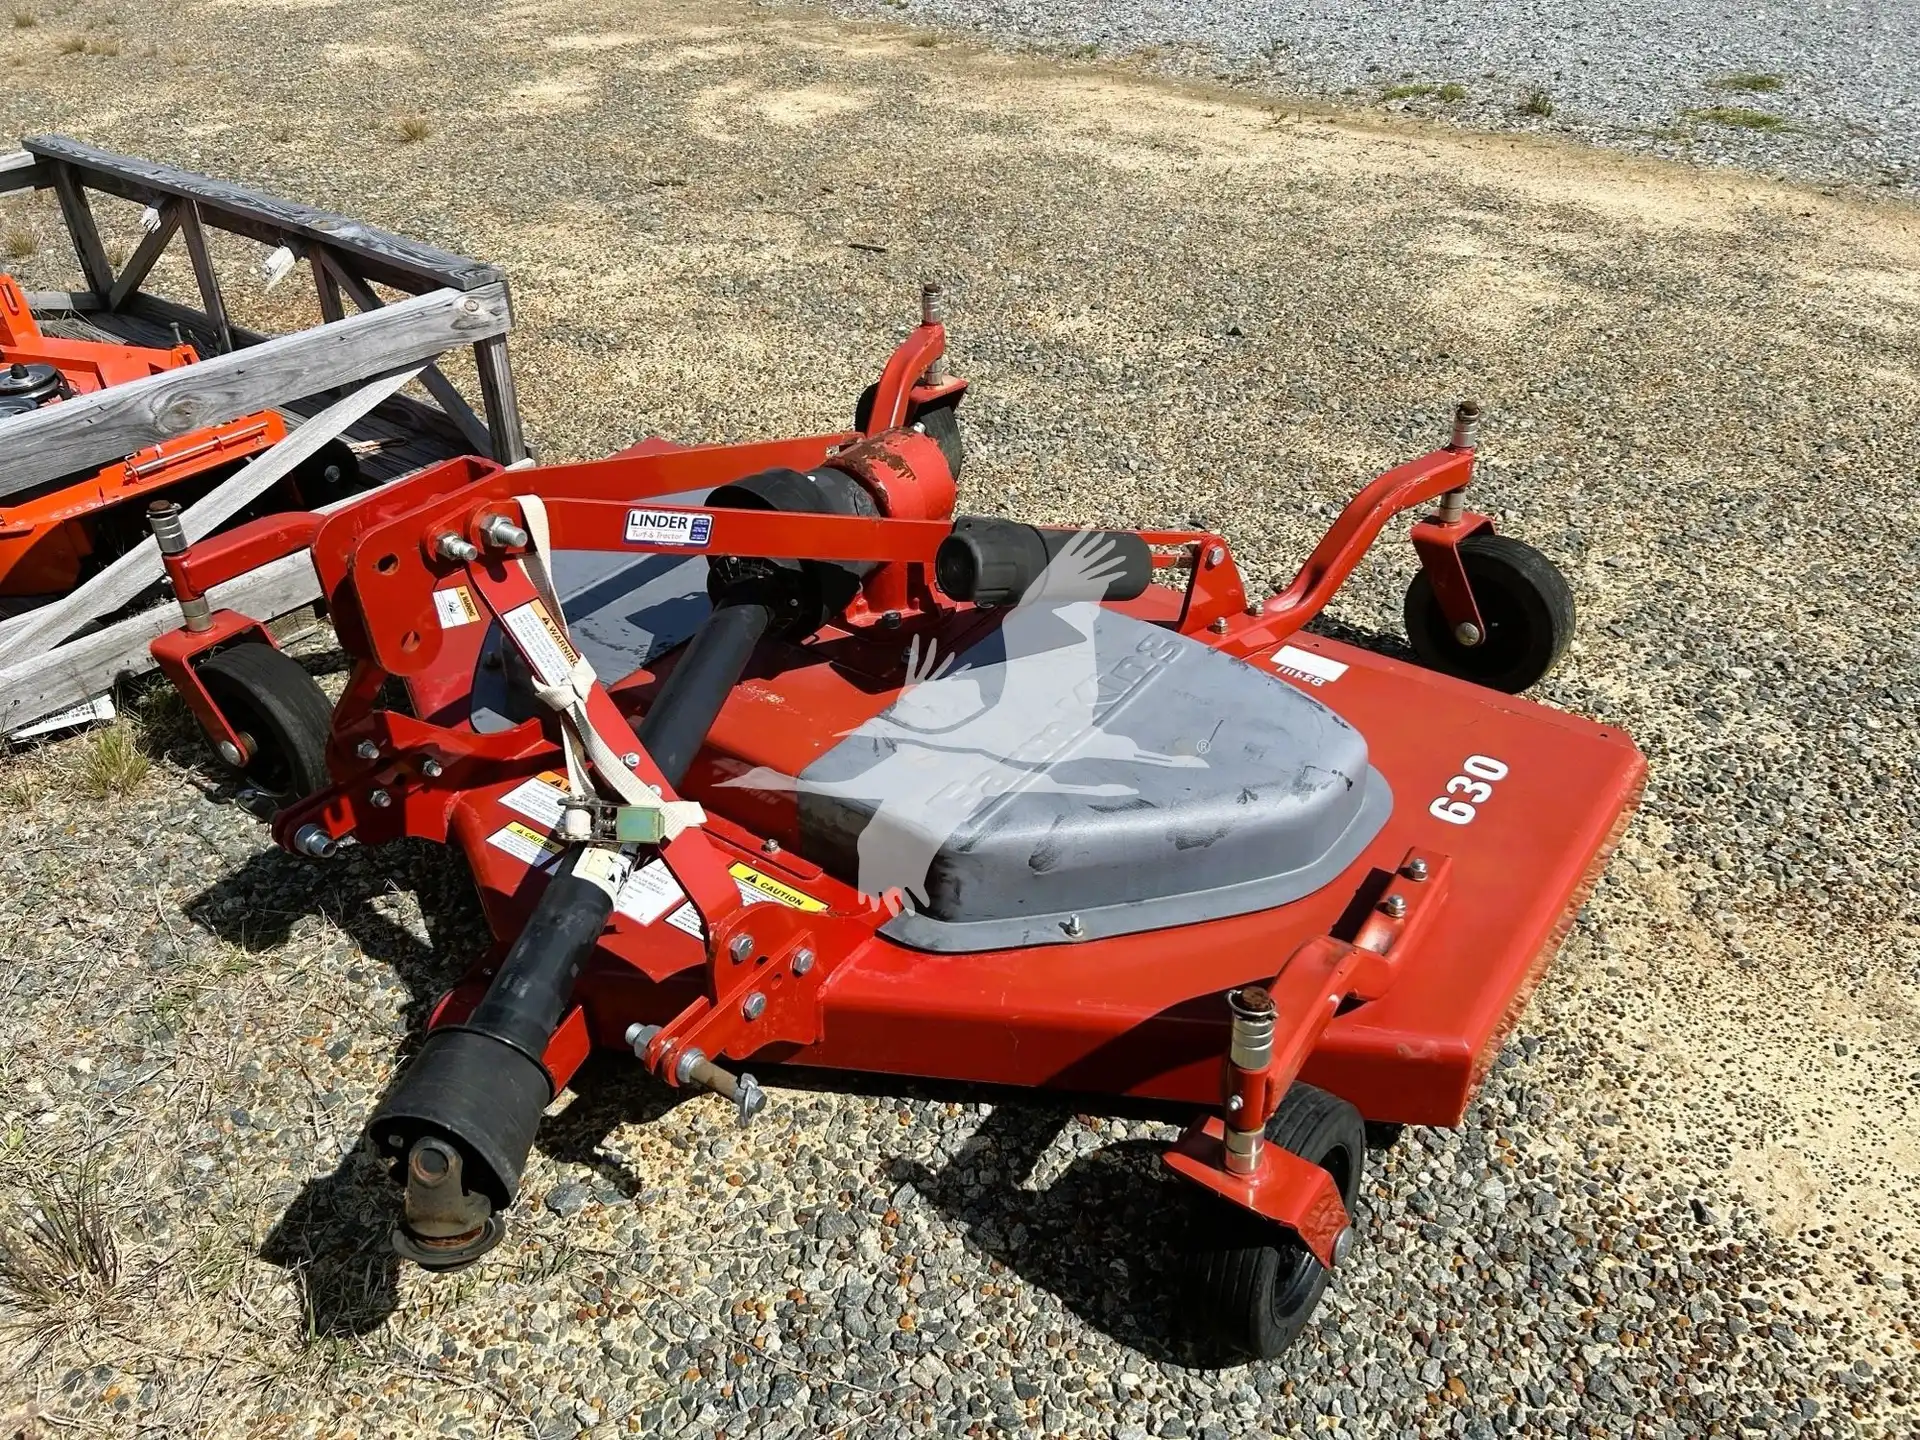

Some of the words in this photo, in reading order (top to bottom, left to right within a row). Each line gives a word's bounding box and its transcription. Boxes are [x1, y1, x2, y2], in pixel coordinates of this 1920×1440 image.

[630, 513, 688, 529] LINDER
[632, 530, 647, 538] Turf
[656, 531, 684, 540] Tractor
[1429, 754, 1509, 825] 630
[525, 832, 554, 849] CAUTION
[760, 882, 804, 906] CAUTION
